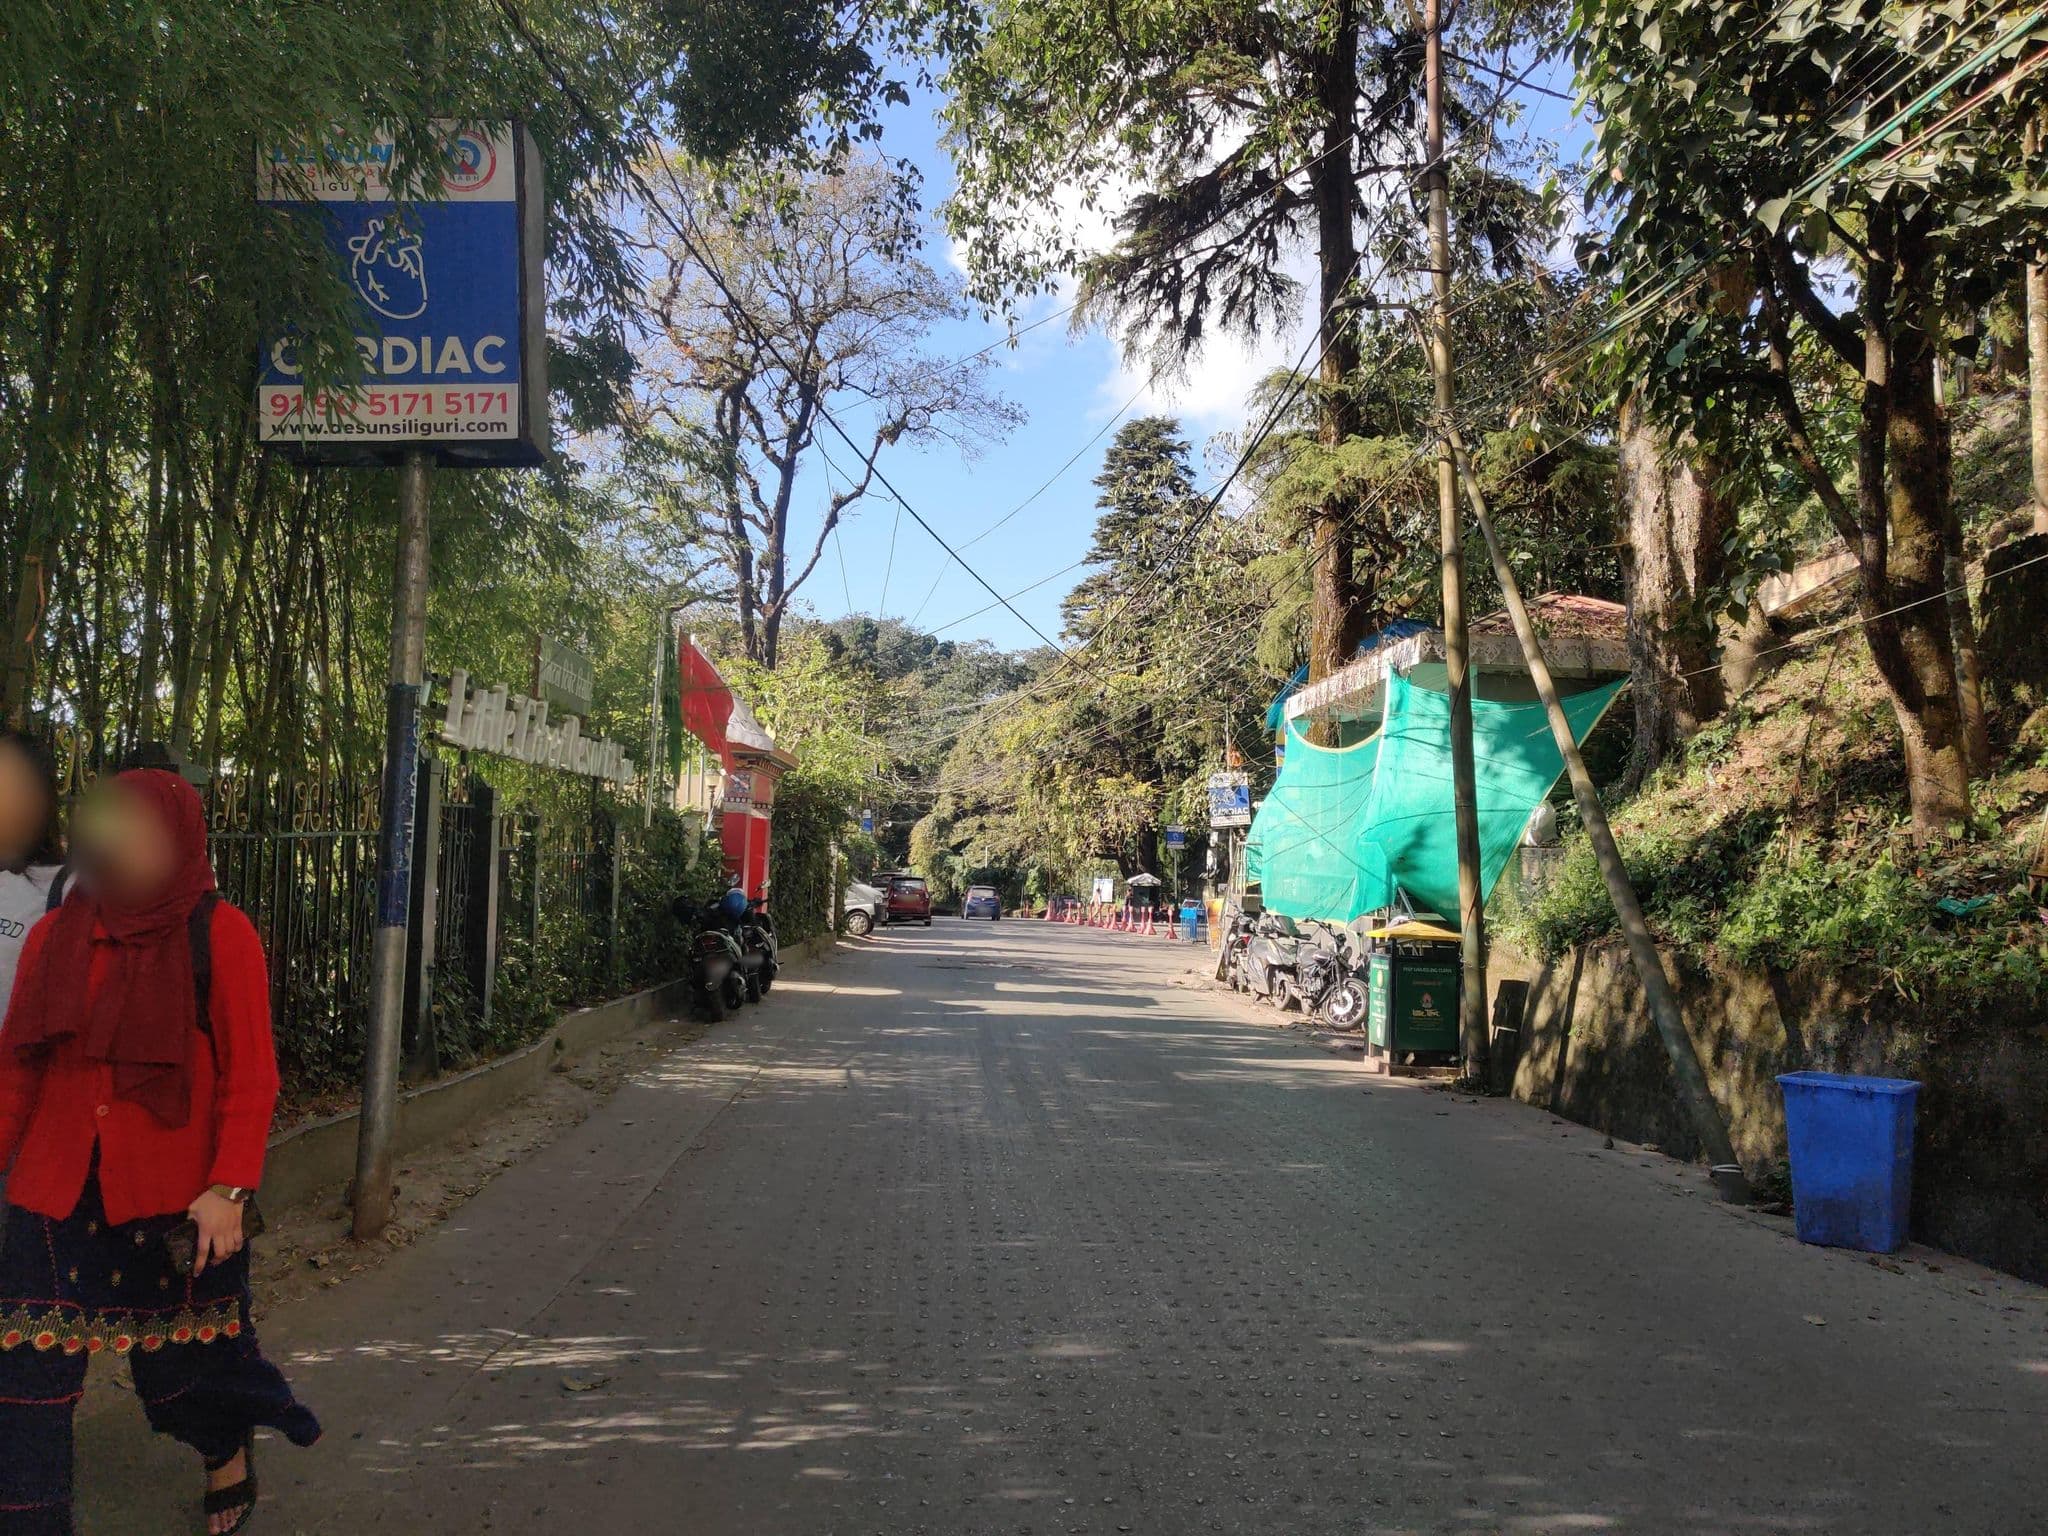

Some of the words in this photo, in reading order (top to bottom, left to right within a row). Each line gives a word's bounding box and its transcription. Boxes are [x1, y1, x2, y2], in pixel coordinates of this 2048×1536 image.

[271, 336, 506, 375] CRDIAC
[369, 392, 433, 415] 5171
[445, 392, 507, 414] 5171
